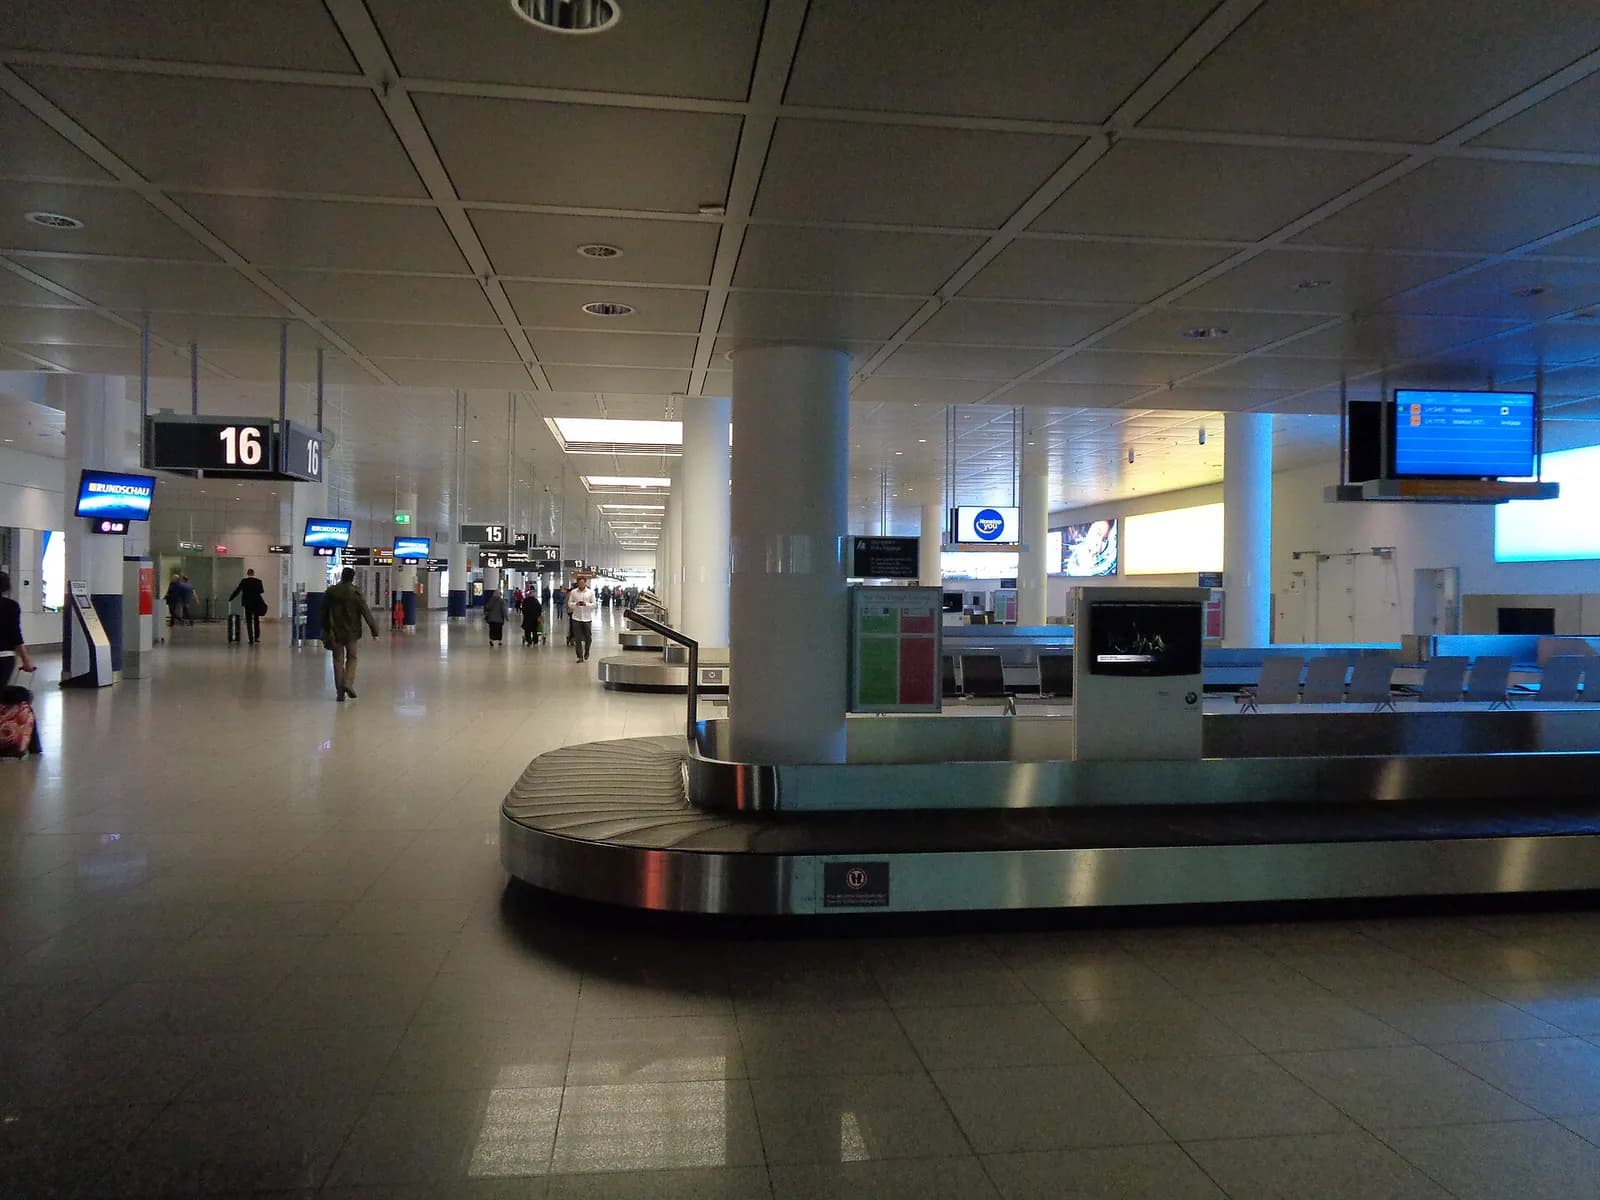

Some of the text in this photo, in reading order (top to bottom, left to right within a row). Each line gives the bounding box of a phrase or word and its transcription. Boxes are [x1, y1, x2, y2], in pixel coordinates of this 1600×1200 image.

[220, 427, 262, 465] 16
[307, 439, 319, 475] 16
[96, 483, 150, 496] RUNDSCHAU
[486, 526, 502, 542] 15
[546, 549, 556, 560] 14
